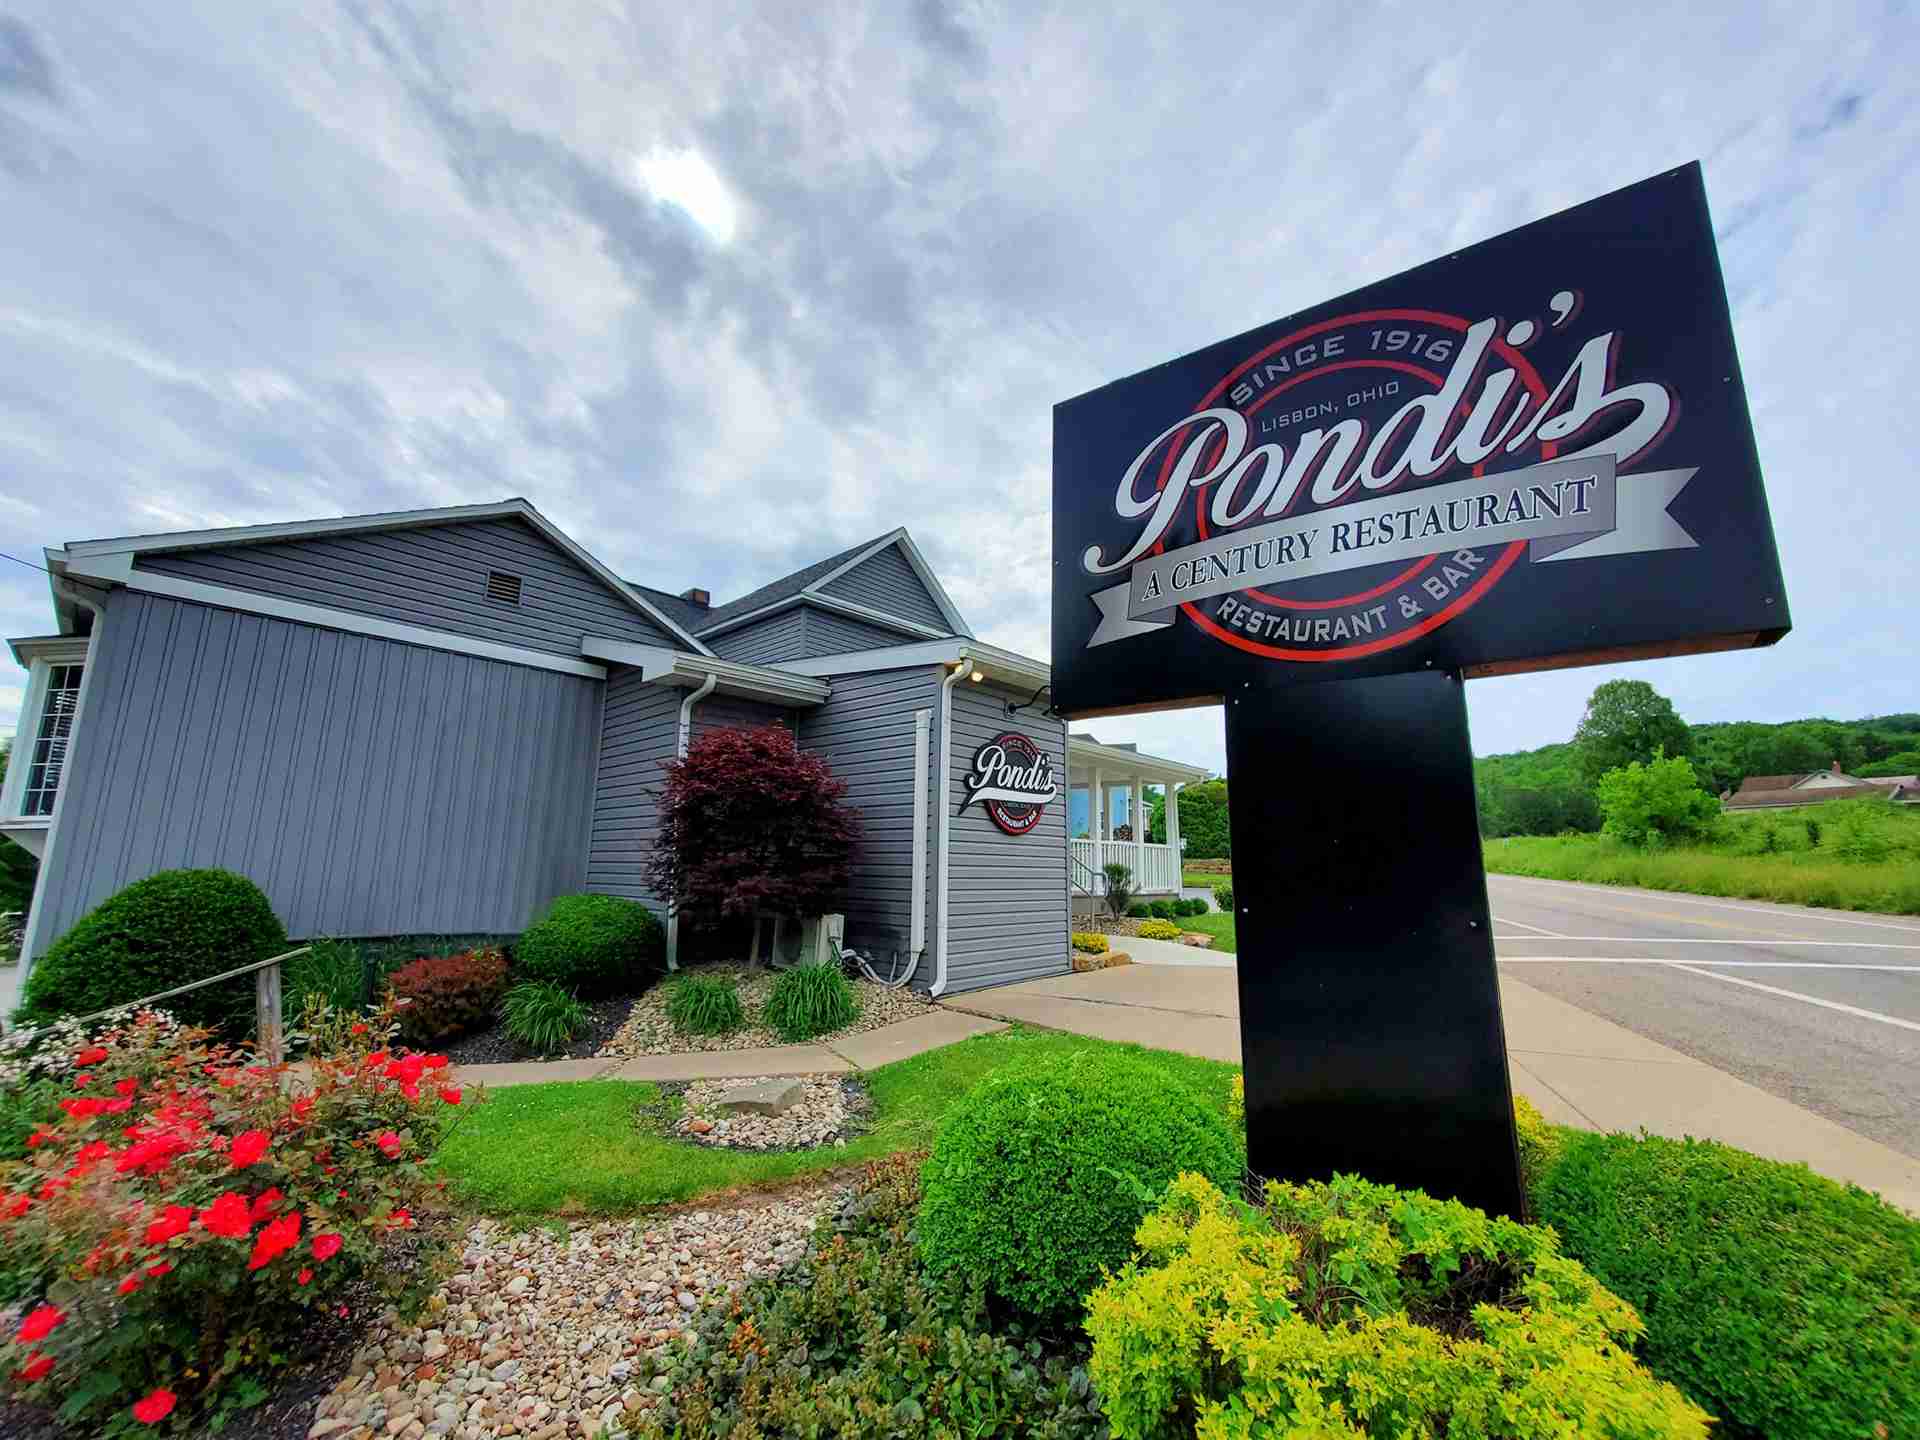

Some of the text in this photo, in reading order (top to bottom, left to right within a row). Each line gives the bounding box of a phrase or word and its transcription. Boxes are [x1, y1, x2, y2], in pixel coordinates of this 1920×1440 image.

[1229, 329, 1453, 406] SINCE 1916
[1261, 380, 1400, 433] LISBON, OHIO
[1082, 291, 1672, 574] Pondi's
[1141, 475, 1600, 602] A CENTURY RESTAURANT
[1216, 547, 1486, 643] RESTAURANT & BAR
